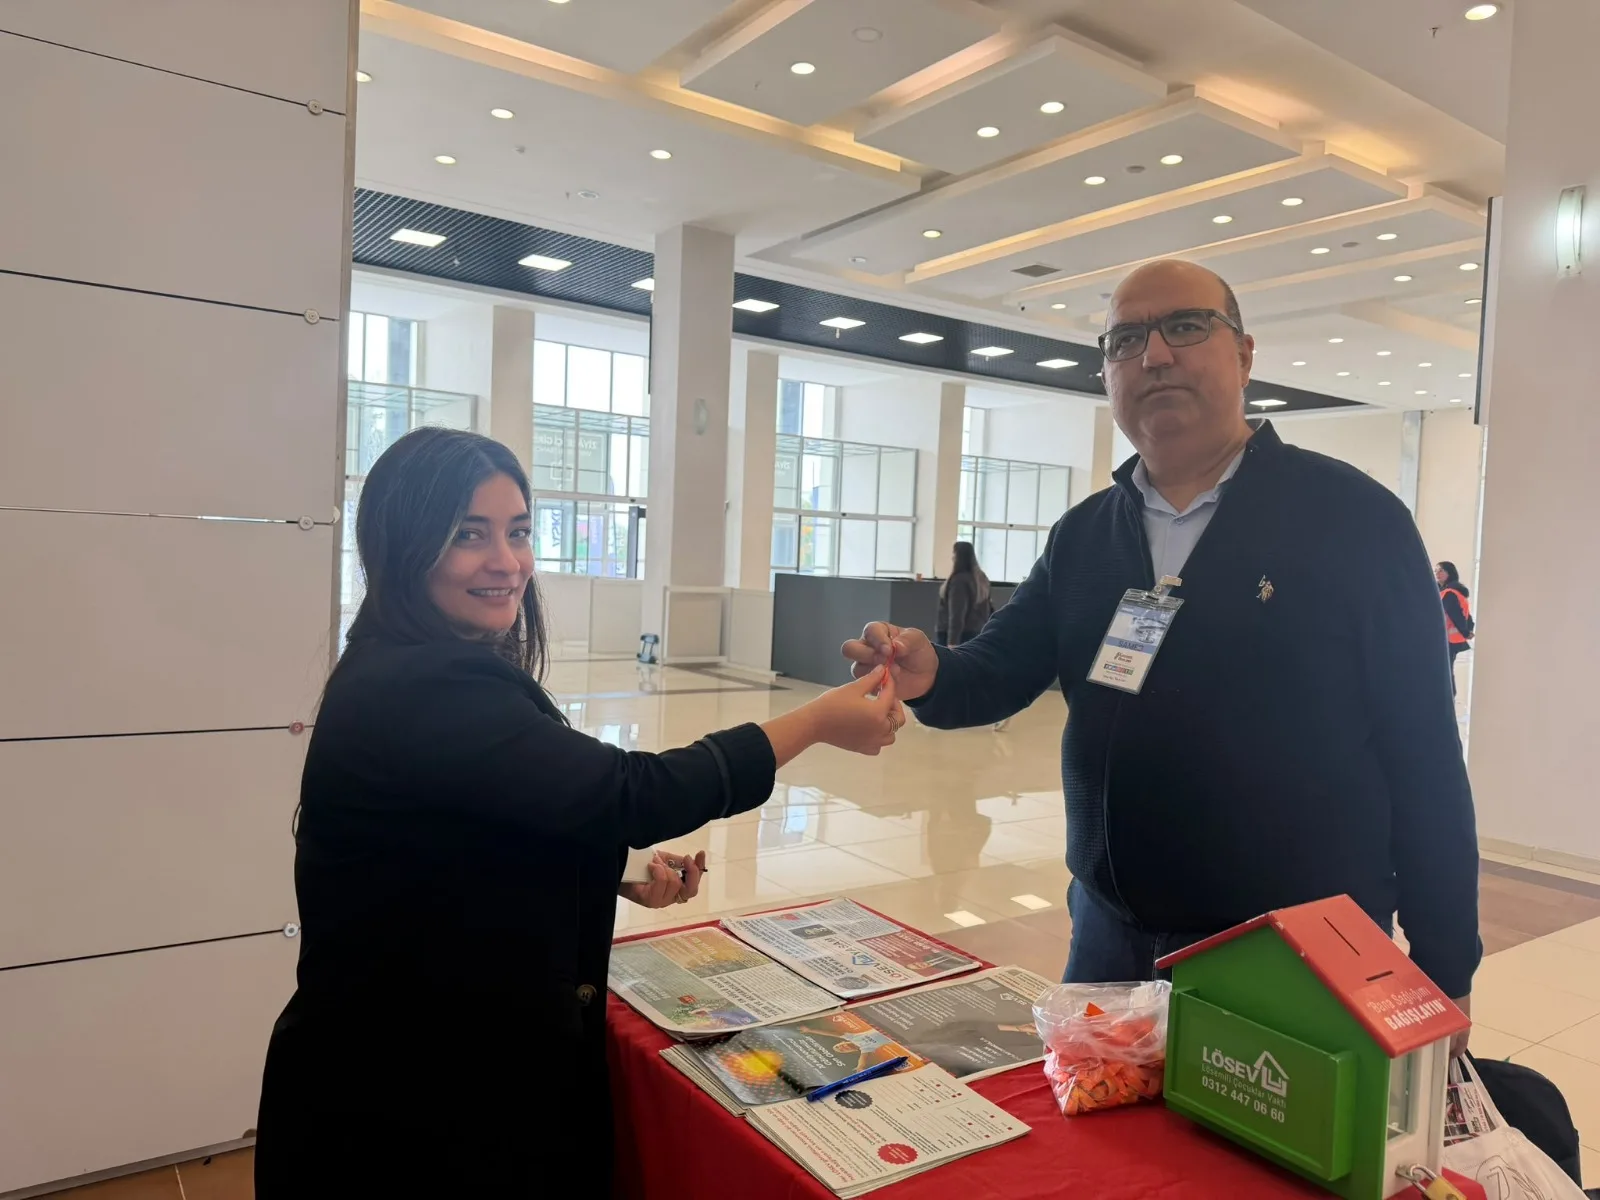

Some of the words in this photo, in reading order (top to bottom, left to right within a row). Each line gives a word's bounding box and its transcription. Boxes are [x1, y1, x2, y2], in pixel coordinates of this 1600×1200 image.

[1201, 1063, 1232, 1083] Lösemili
[1233, 1077, 1265, 1098] Çocuklar
[1267, 1093, 1287, 1109] Vakfı
[1202, 1046, 1260, 1083] LÖSEV
[1202, 1076, 1228, 1096] 0312
[1230, 1089, 1251, 1107] 447
[1253, 1100, 1268, 1115] 06
[1270, 1108, 1285, 1123] 60
